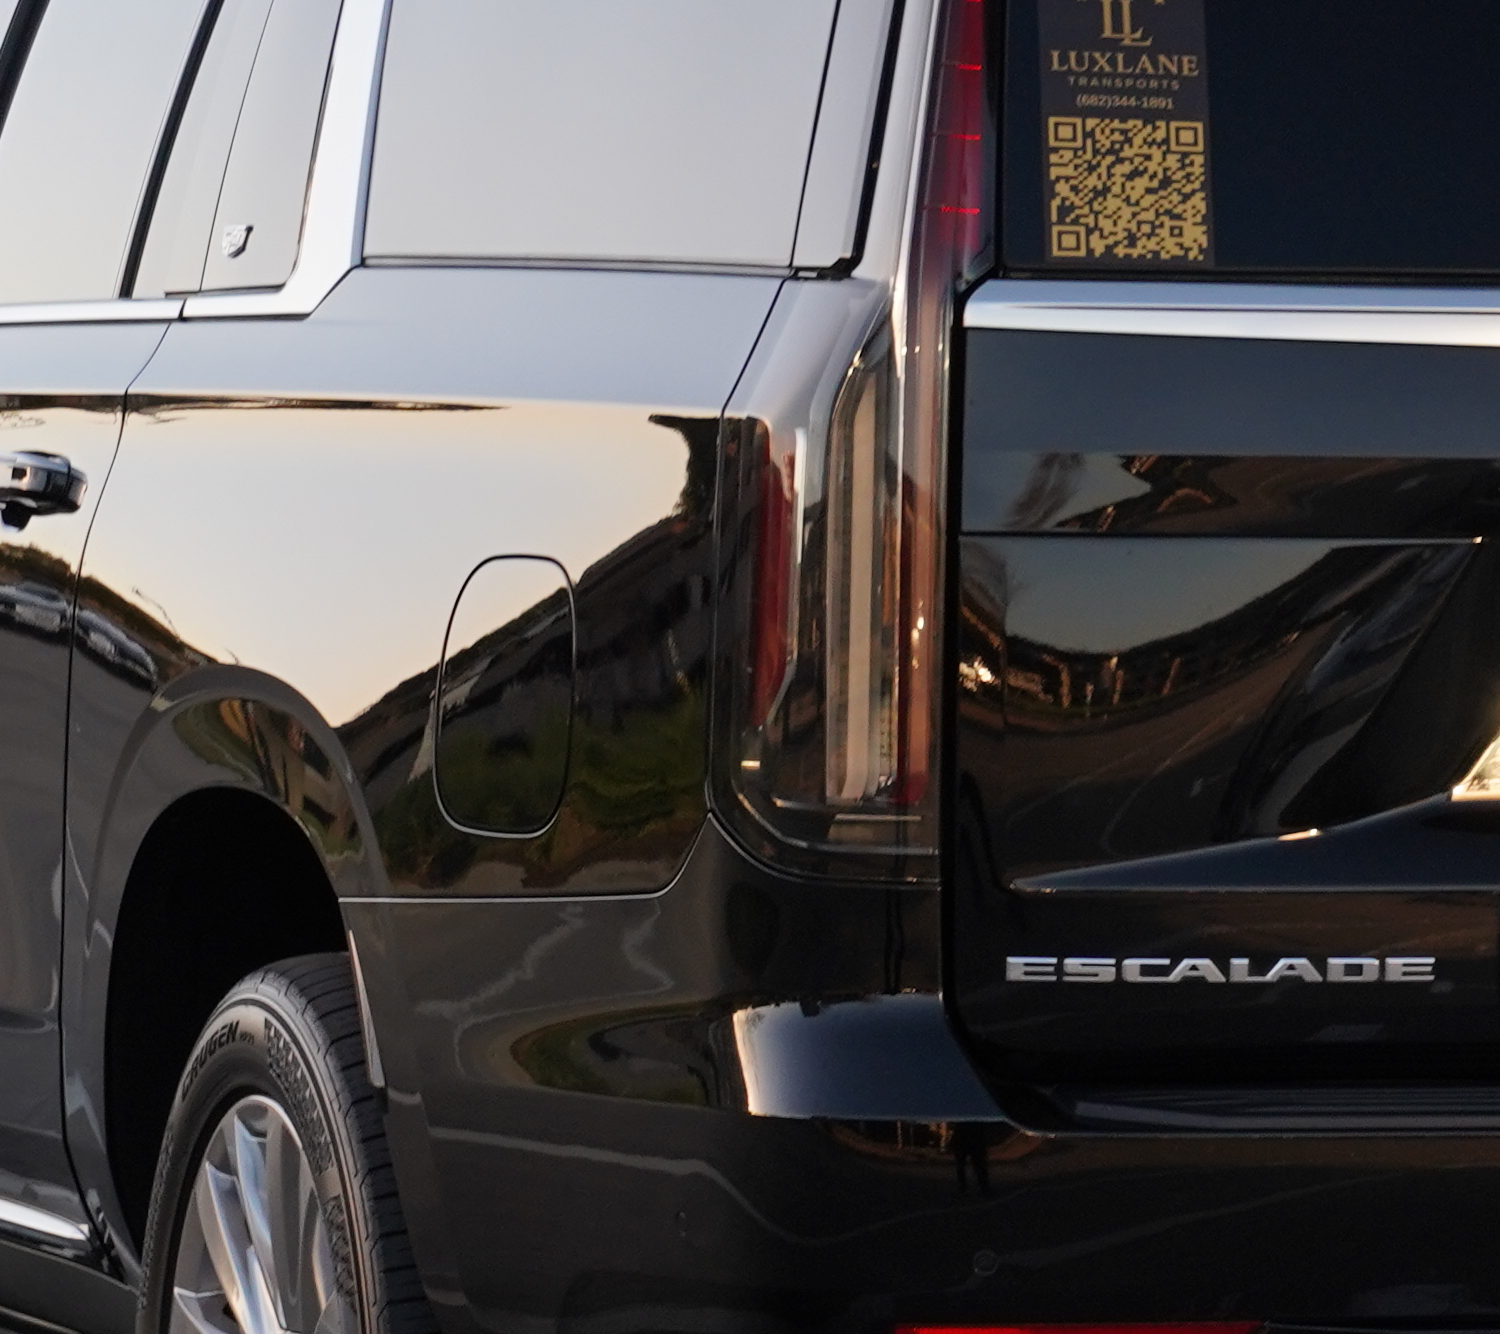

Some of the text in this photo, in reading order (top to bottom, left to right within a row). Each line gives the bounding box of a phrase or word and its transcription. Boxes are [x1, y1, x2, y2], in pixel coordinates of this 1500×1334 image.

[1050, 49, 1199, 77] LUXLANE
[1067, 75, 1180, 91] TRANSPORTS
[1005, 956, 1437, 984] ESCALADE
